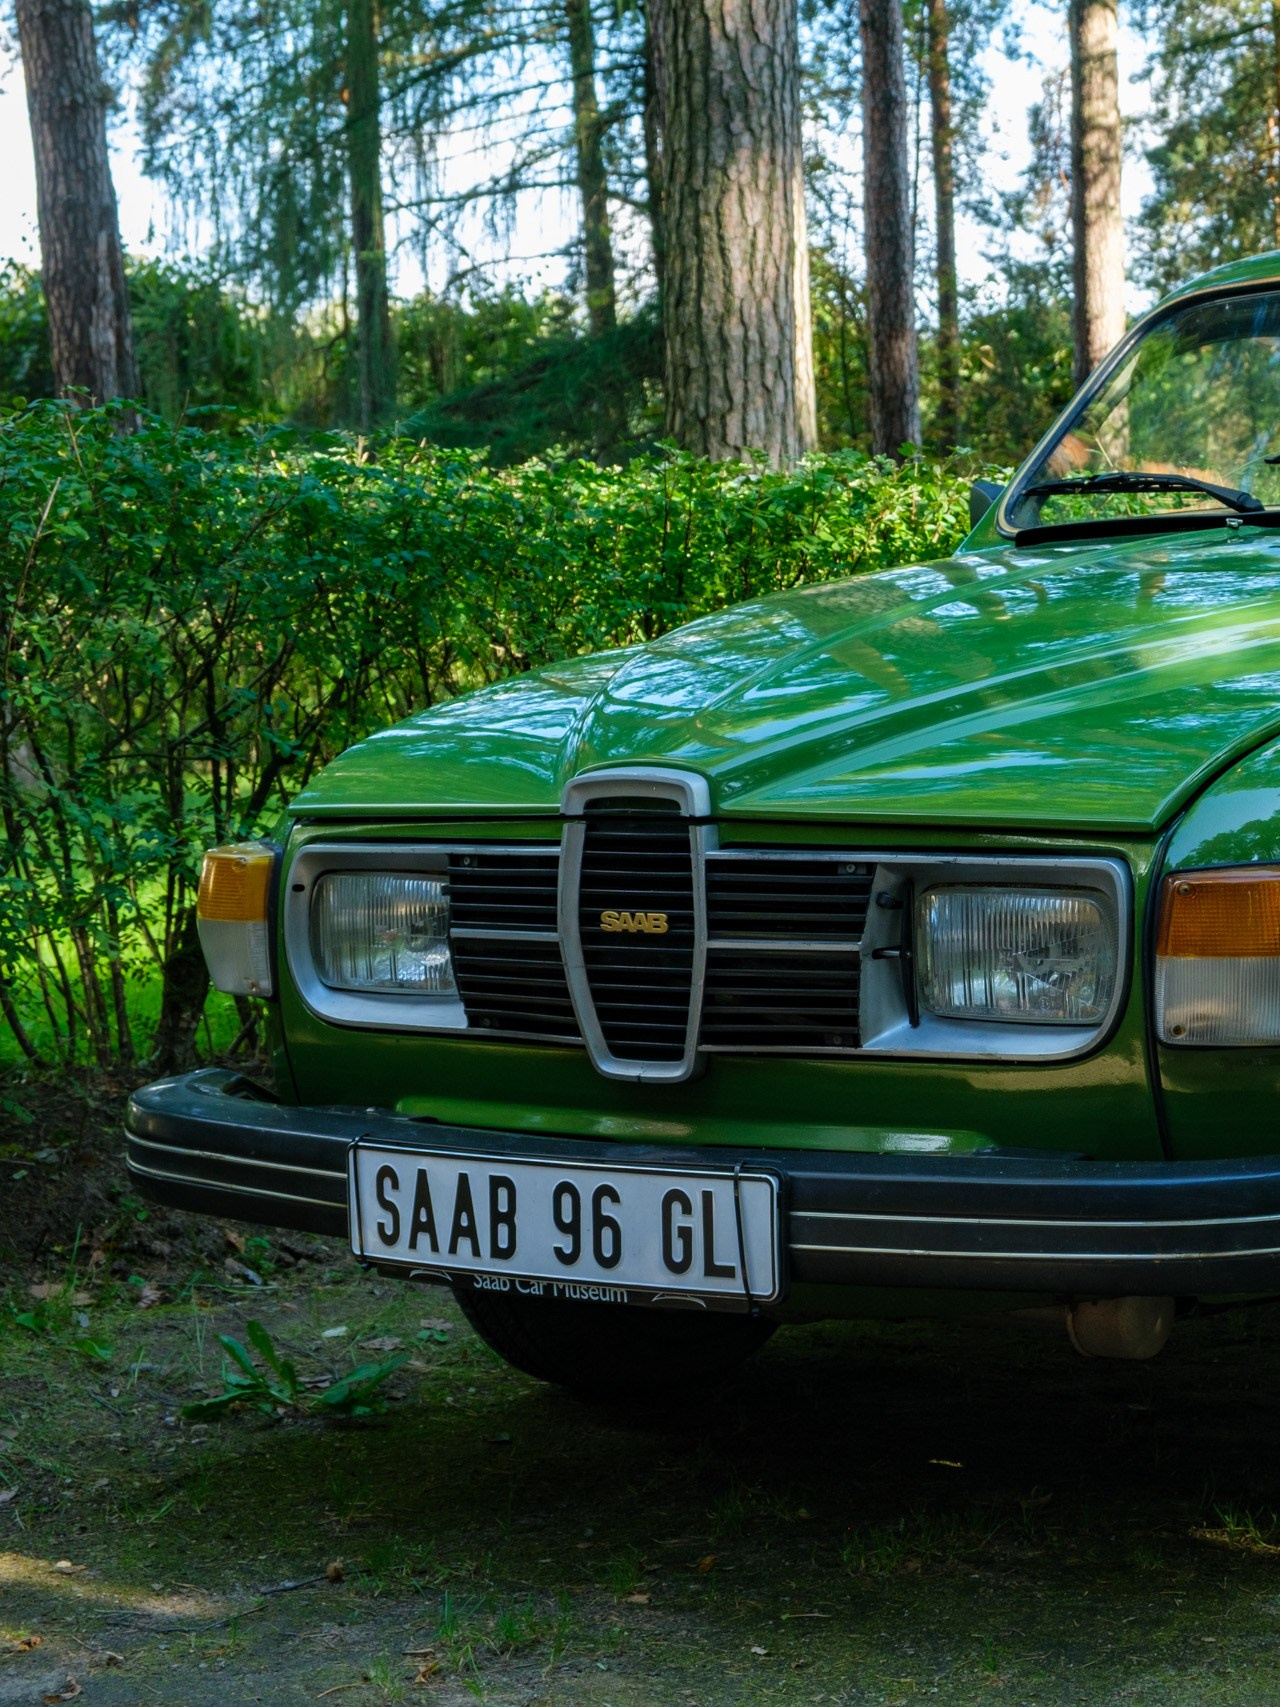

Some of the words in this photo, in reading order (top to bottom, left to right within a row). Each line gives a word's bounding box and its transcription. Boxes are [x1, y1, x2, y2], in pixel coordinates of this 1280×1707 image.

[600, 911, 668, 933] SAAB
[375, 1164, 517, 1261] SAAB
[552, 1180, 622, 1270] 96
[661, 1187, 737, 1279] GL
[473, 1274, 510, 1292] Saab
[515, 1278, 548, 1295] Car
[552, 1282, 628, 1303] Museum
